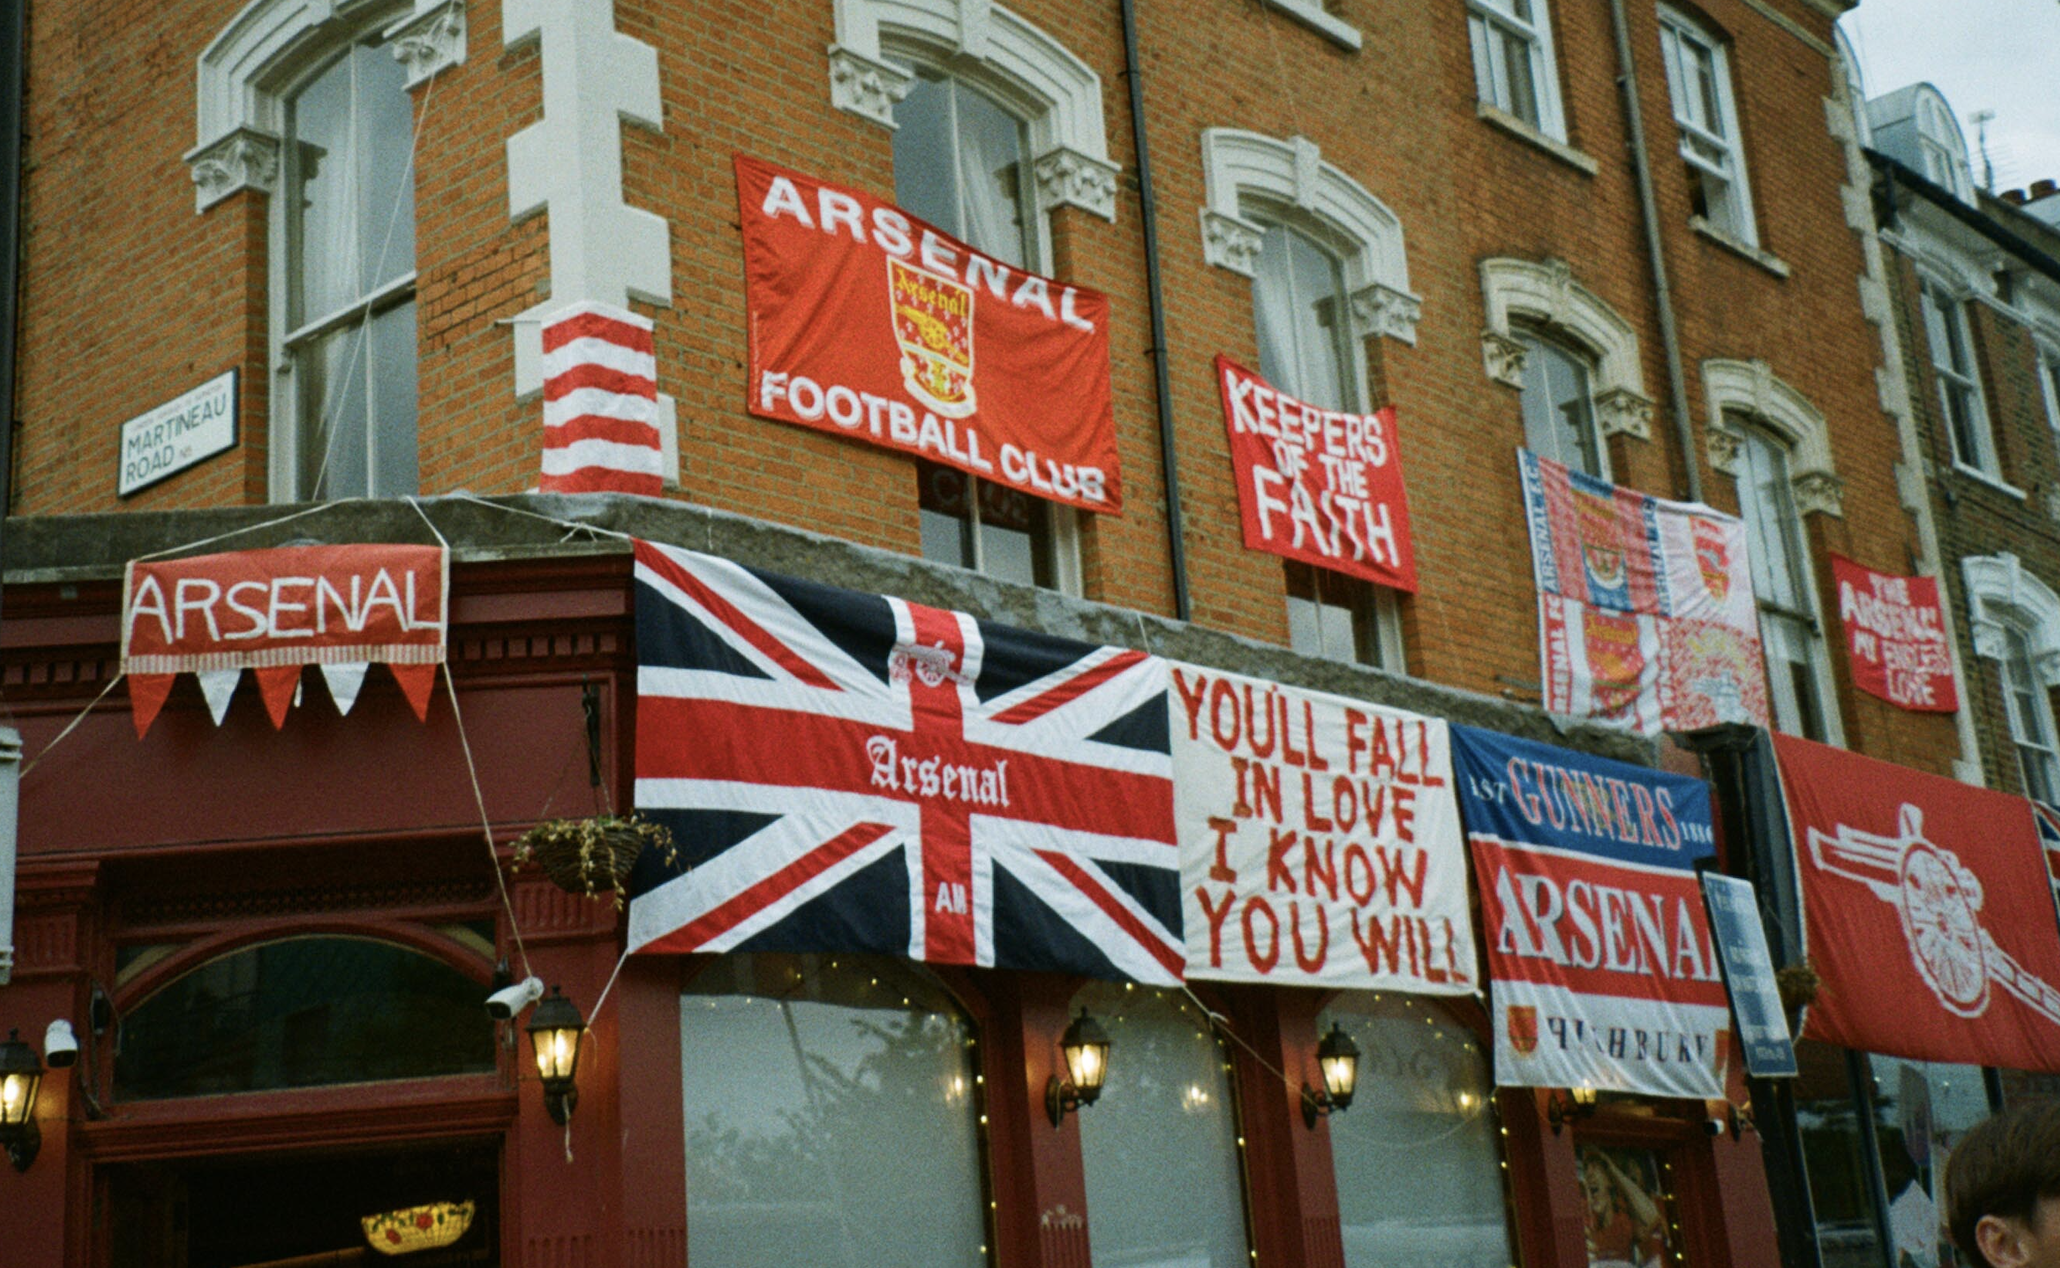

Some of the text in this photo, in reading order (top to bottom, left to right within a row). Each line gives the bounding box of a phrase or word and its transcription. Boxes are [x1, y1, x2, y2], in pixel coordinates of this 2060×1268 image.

[763, 176, 1094, 332] ARSENAL
[127, 392, 226, 459] MARTINEAU
[760, 370, 994, 474] FOOTBALL
[1001, 442, 1107, 503] CLUB
[1225, 369, 1387, 467] KEEPERS
[126, 444, 175, 485] ROAD
[1273, 438, 1370, 499] OF THE
[1252, 465, 1400, 568] FAITH
[1534, 504, 1558, 592] ARSENAL
[130, 568, 441, 645] ARSENAL
[1868, 573, 1911, 605] THE
[866, 735, 1010, 807] Arsenal
[1345, 707, 1445, 787] FALL
[1230, 756, 1416, 844] IN LOVE
[1506, 756, 1682, 851] GUNNERS
[1208, 816, 1427, 909] I KNOW
[1195, 885, 1469, 984] YOU WILL
